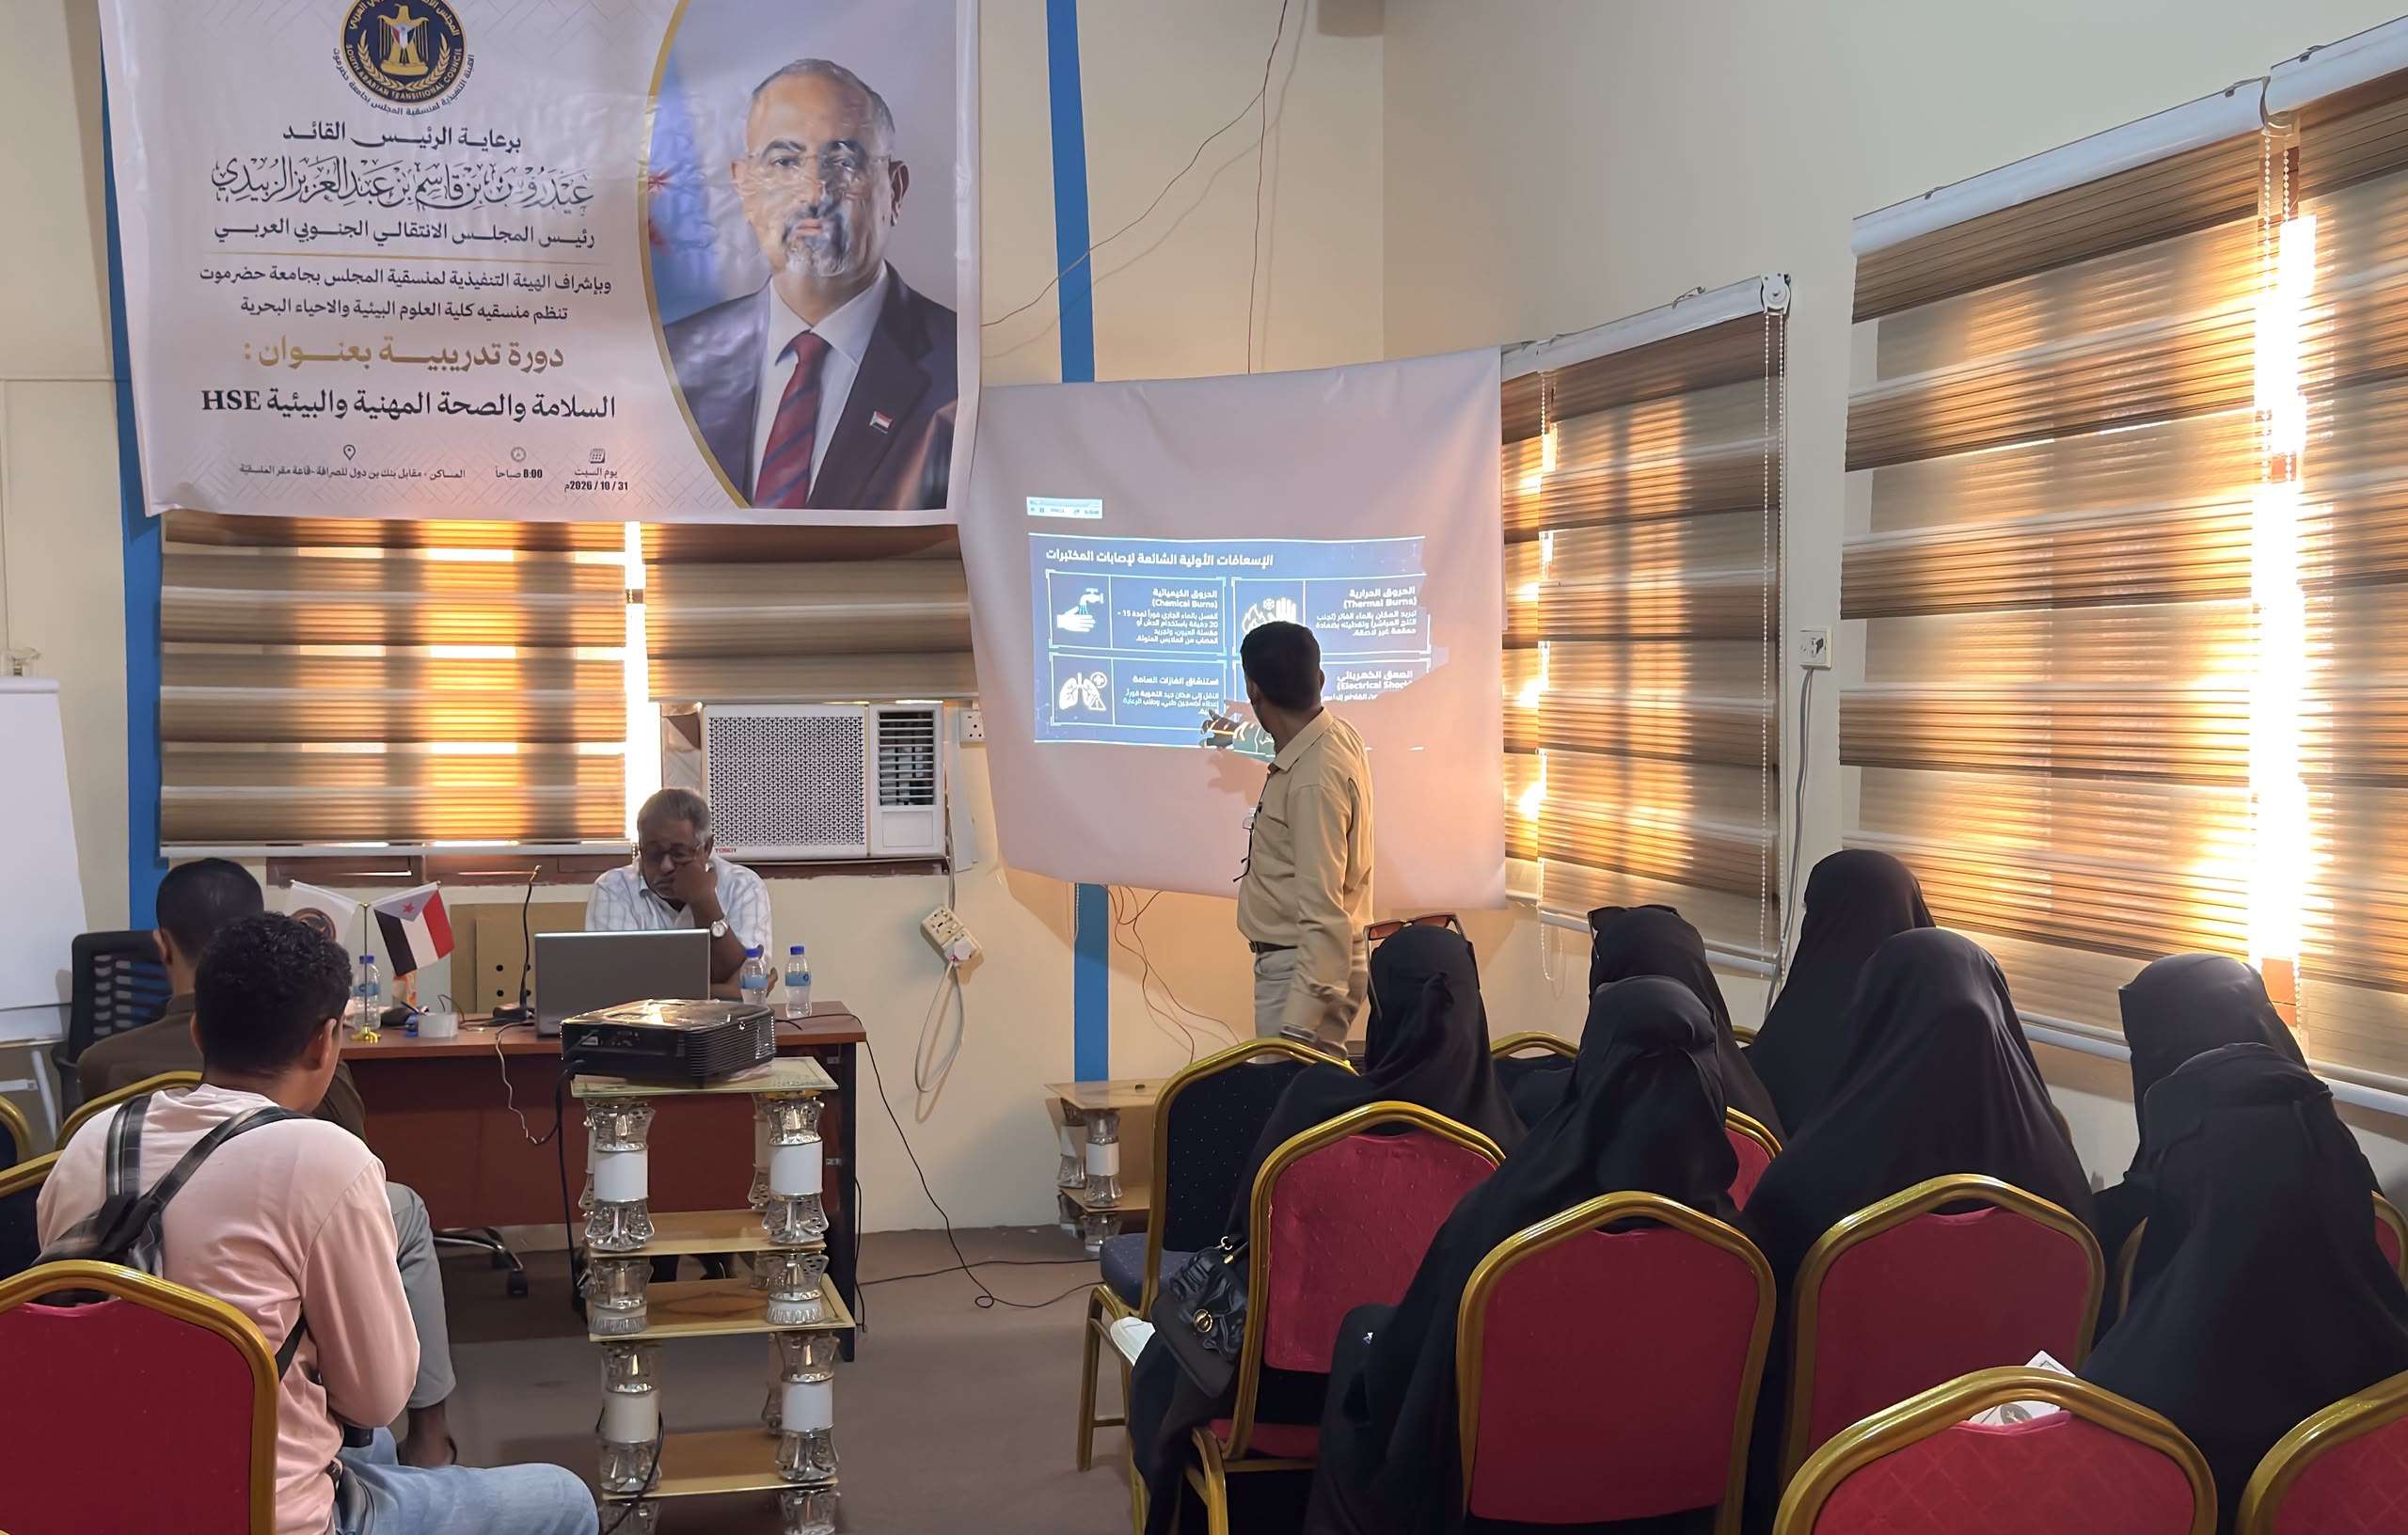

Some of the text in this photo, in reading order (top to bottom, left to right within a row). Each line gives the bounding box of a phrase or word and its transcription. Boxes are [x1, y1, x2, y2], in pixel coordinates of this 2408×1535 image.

[345, 44, 464, 101] SOUTH ARABIAN TRANSITIONAL COUNCIL
[371, 101, 404, 115] المجلس
[283, 120, 522, 153] برعاية الرئيس القائد
[215, 217, 595, 249] رئيس المجلس الانتقالي الجنوبي العربي
[199, 266, 611, 295] وبإشراف الهيئة التنفيذية لمنسقية المجلس بجامعة حضرموت
[241, 297, 568, 324] تنظم منسقيه كلية العلوم البيئية والاحياء البحرية
[259, 335, 372, 369] بعنوان
[379, 336, 501, 372] تدريبية
[508, 341, 564, 373] دورة
[201, 388, 615, 423] السلامة والصحة المهنية والبيئية HSE
[574, 467, 617, 481] يوم السبت
[618, 481, 628, 491] 31
[1046, 547, 1274, 569] الإسعافات الأولية الشائعة لإصابات المختبرات
[1344, 596, 1418, 609] (Thermal Burns)
[1349, 586, 1416, 598] الحروق الحرارية
[1337, 671, 1413, 682] الصعق الكهربائي
[1337, 681, 1382, 691] (Electrical
